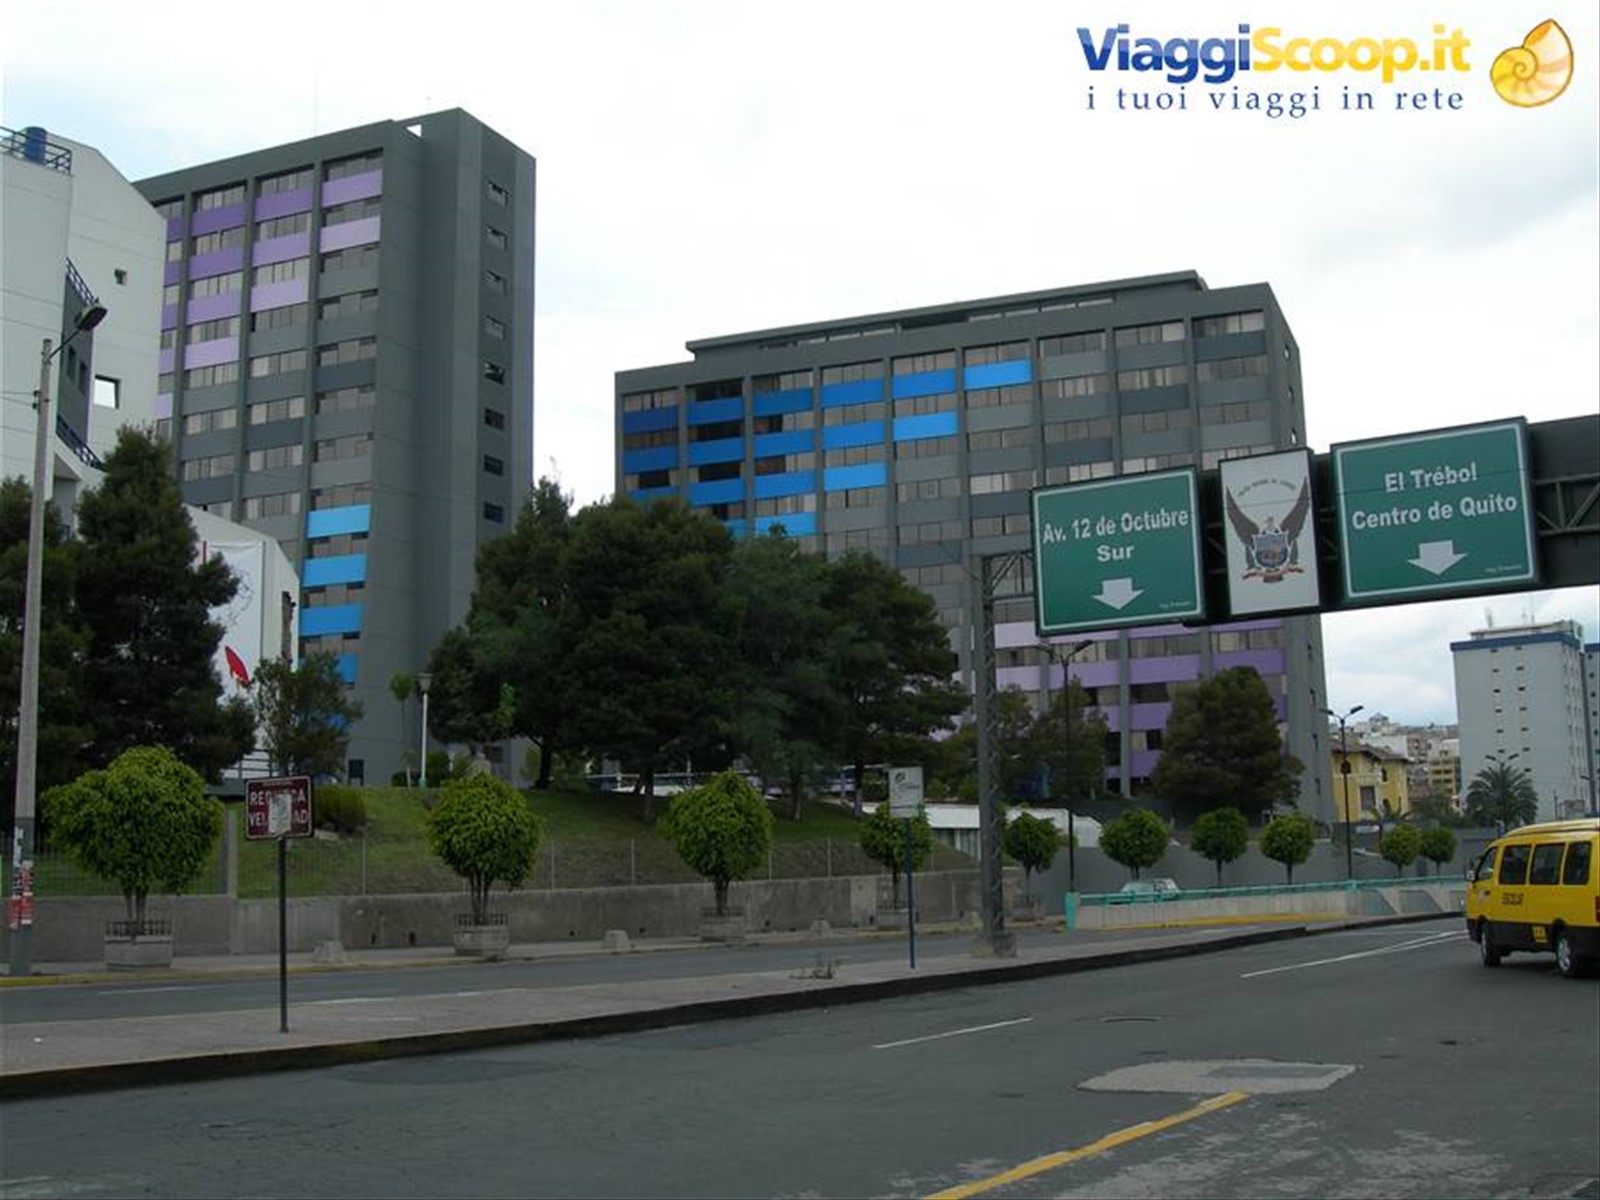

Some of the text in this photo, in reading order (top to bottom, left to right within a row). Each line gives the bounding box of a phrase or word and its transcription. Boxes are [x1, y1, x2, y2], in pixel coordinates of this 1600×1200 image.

[1385, 461, 1478, 493] El Trébol
[1042, 507, 1189, 545] Av. 12 de Octubre
[1352, 493, 1518, 530] Centro de Quito
[1097, 544, 1135, 562] Sur
